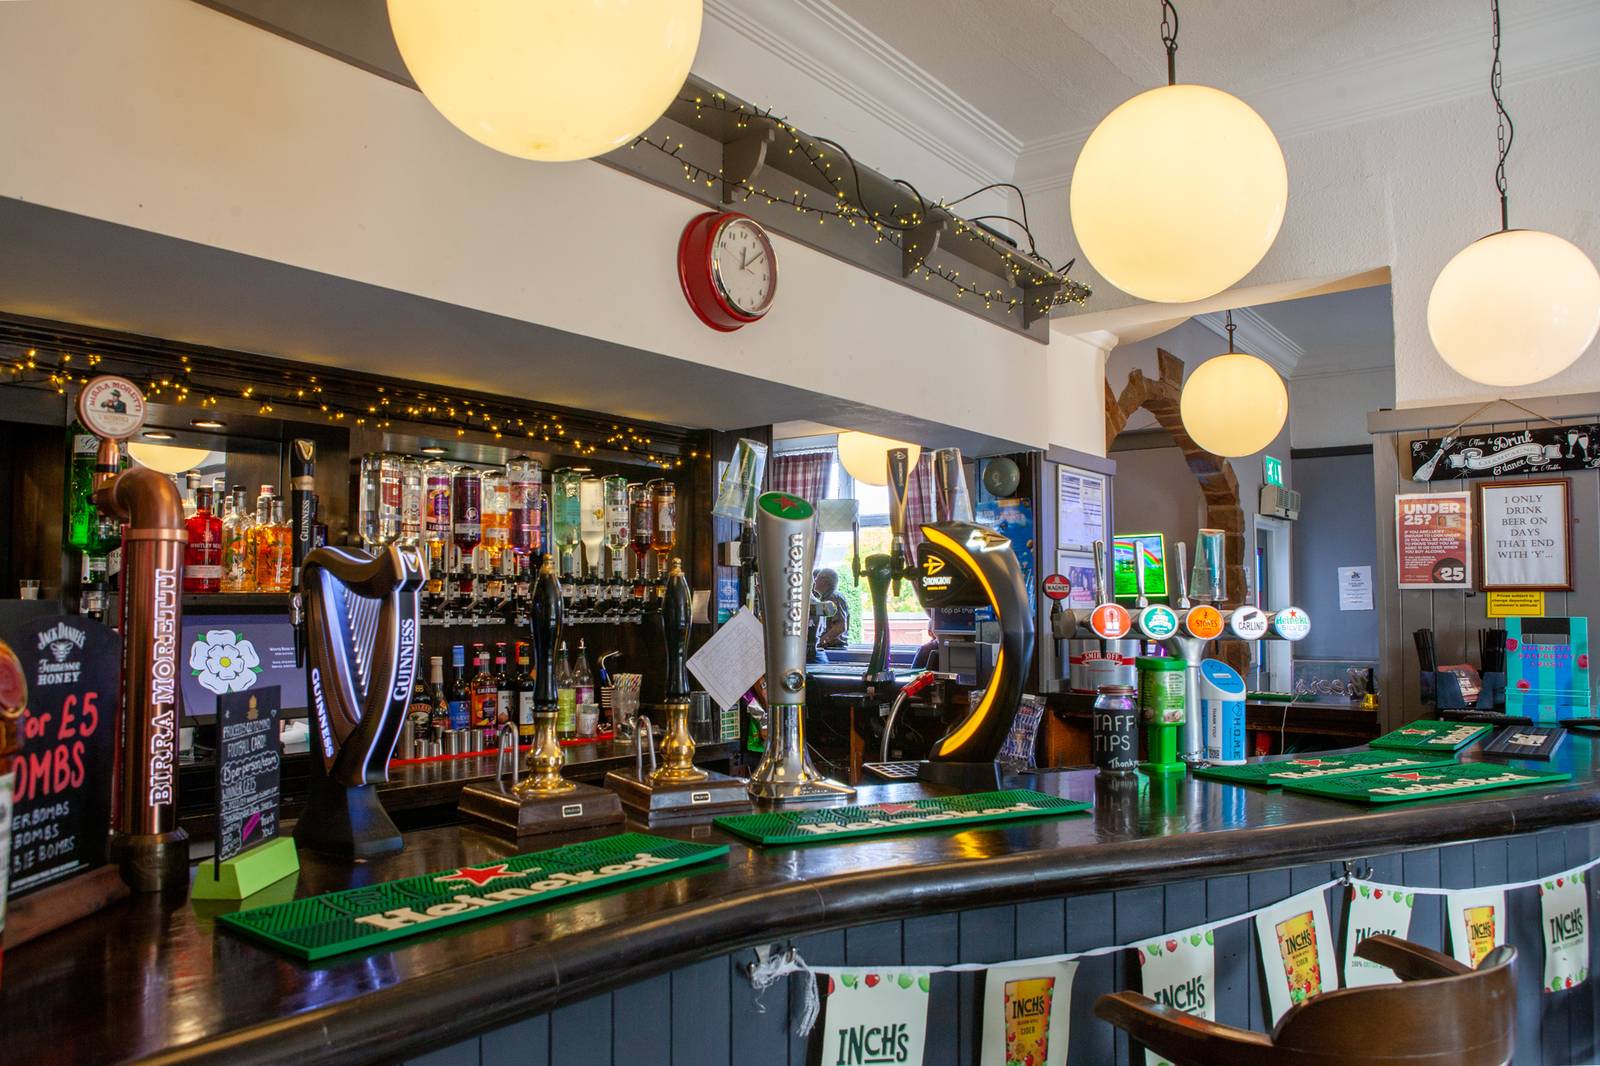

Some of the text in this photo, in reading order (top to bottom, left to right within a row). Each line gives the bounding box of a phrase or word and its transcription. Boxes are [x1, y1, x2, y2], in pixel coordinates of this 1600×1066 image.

[1492, 430, 1534, 451] Drink
[1503, 459, 1527, 472] dance
[1404, 502, 1461, 514] UNDER
[1504, 494, 1543, 504] I ONLY
[1506, 505, 1543, 515] DRINK
[299, 499, 311, 543] GUINNESS
[1404, 514, 1432, 526] 25?
[1501, 516, 1548, 526] BEER ON
[1510, 527, 1541, 537] DAYS
[1496, 538, 1555, 548] THAT END
[1497, 550, 1528, 559] WITH
[1440, 567, 1465, 581] 25
[785, 532, 804, 638] Heineken
[1047, 584, 1069, 592] MAGNET
[1195, 619, 1218, 628] STONES
[1238, 621, 1265, 631] CARLING
[37, 626, 58, 651] JACK
[392, 618, 416, 701] GUINNESS
[1084, 651, 1120, 660] SMIROFF
[38, 658, 81, 674] Tennessee
[37, 671, 82, 686] HONEY
[149, 567, 177, 807] BIRRA MORETTI
[23, 691, 99, 740] or £5
[310, 667, 335, 759] GUINNESS
[1094, 713, 1135, 732] TAFF
[1094, 734, 1131, 753] TIPS
[12, 740, 86, 802] OMBS
[38, 834, 77, 862] BOMBS
[354, 853, 681, 931] Heineken
[1471, 921, 1492, 941] INCH'S
[1549, 907, 1584, 945] INCH'S
[1285, 929, 1312, 955] INCH'S
[1153, 975, 1206, 1010] INCH'S
[1012, 995, 1045, 1019] INCH'S
[1020, 1026, 1036, 1036] CIDER
[836, 1023, 910, 1066] INCH'S
